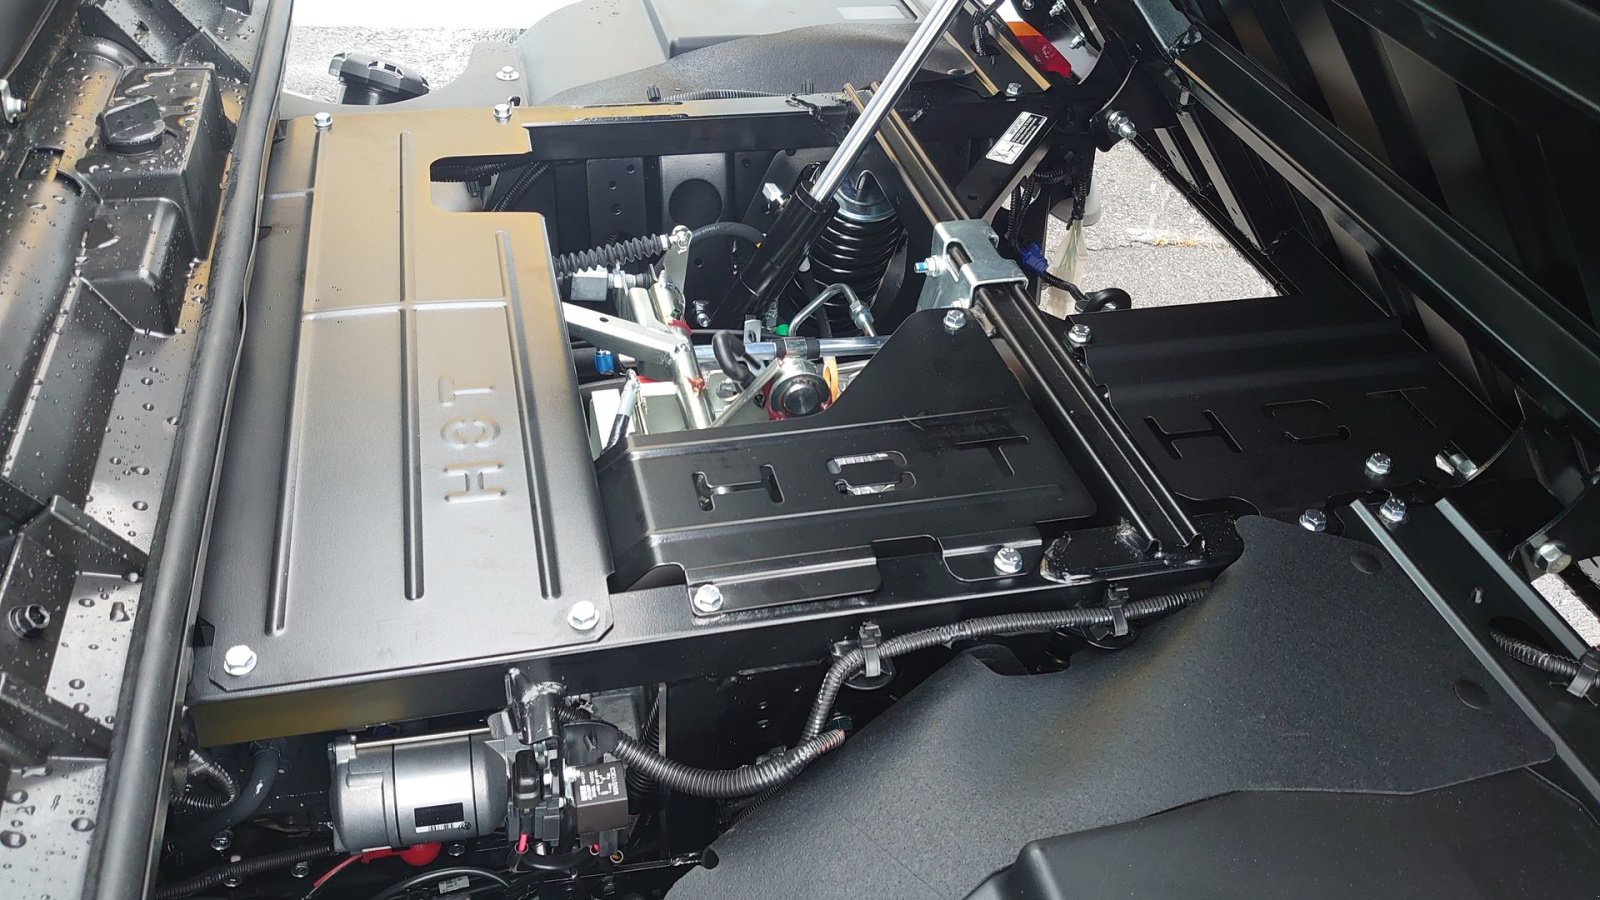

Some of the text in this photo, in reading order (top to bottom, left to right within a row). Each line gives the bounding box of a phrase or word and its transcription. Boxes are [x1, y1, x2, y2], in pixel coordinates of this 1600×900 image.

[438, 376, 505, 504] HOT
[1144, 387, 1437, 460] HOT
[692, 436, 1030, 511] HOT
